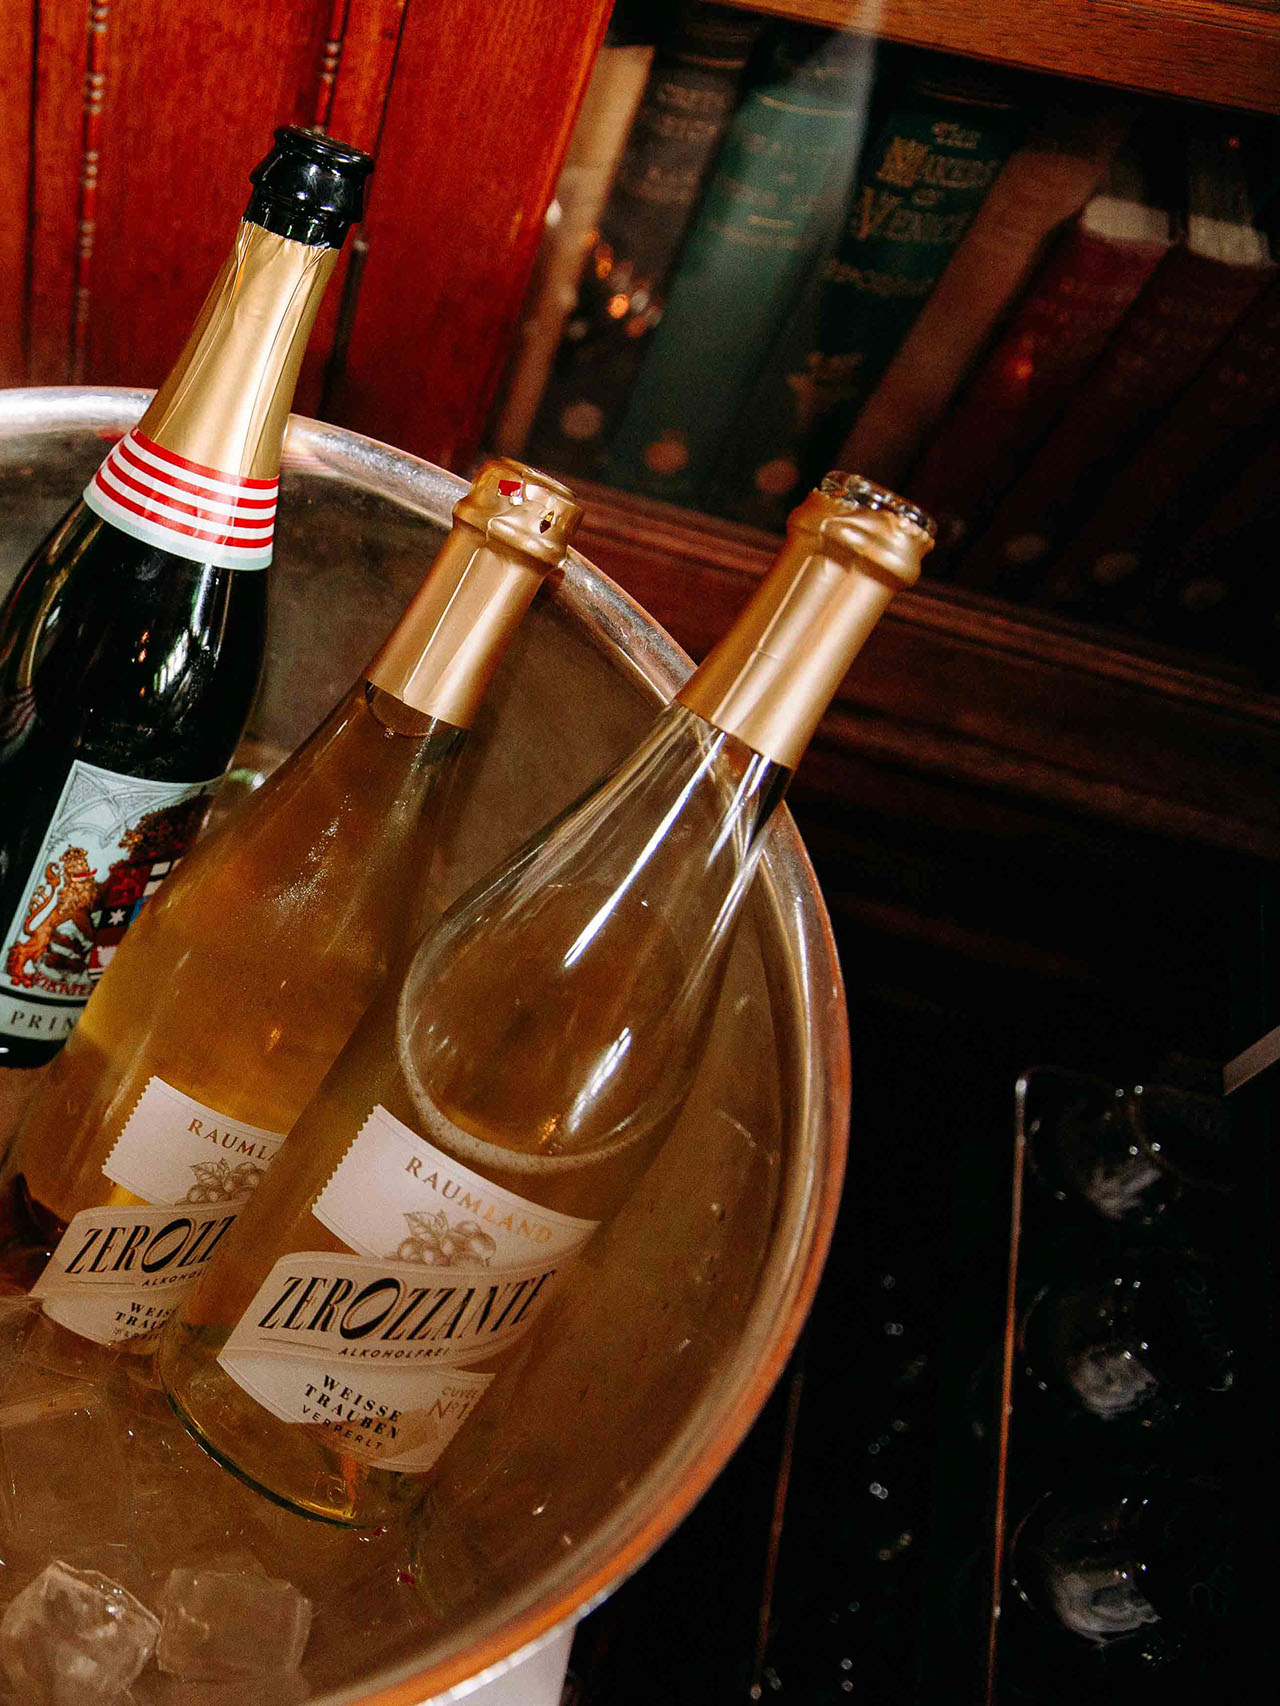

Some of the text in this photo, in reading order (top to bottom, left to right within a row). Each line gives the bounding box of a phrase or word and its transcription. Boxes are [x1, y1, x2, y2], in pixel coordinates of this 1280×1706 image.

[10, 1011, 76, 1032] PRIN
[404, 1156, 554, 1245] RAUMLAND
[336, 1346, 451, 1359] ALKOHOLFREI
[303, 1383, 398, 1440] TRAUBEN
[323, 1374, 402, 1422] WEISSE
[302, 1404, 383, 1450] VERPERLT
